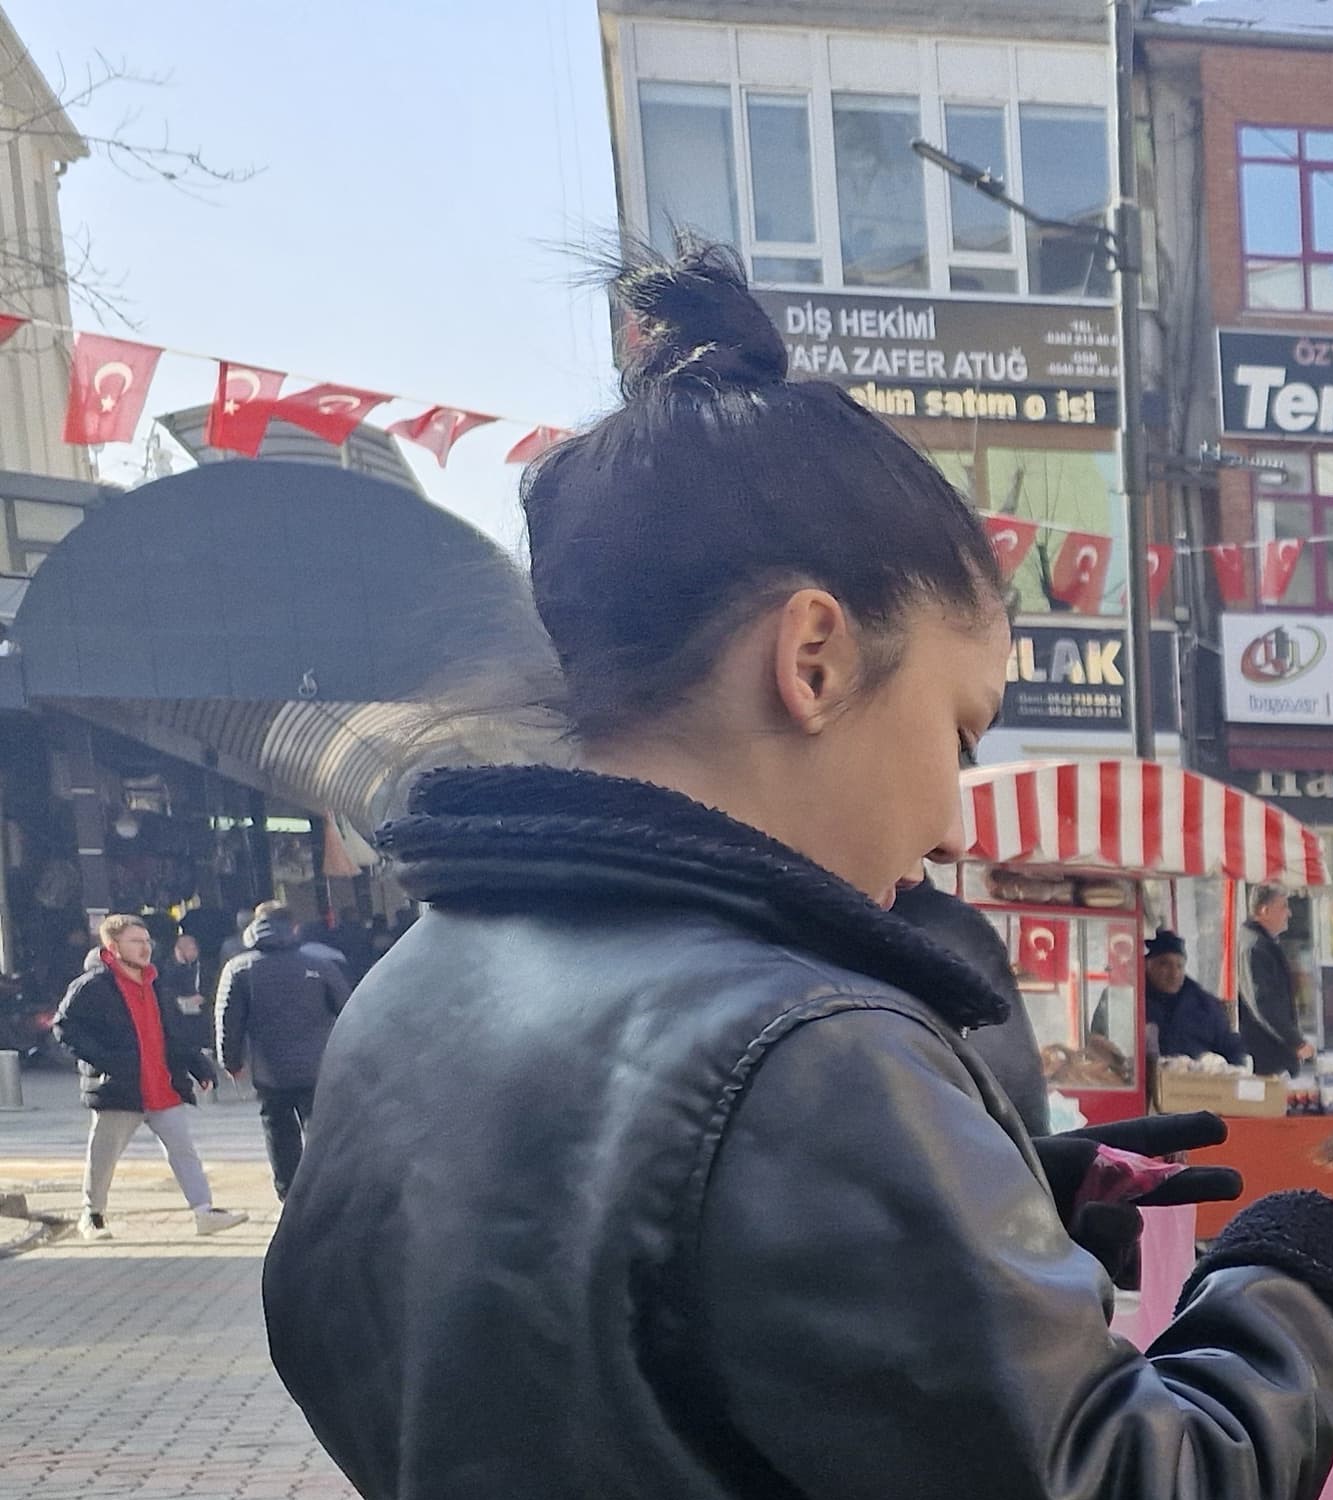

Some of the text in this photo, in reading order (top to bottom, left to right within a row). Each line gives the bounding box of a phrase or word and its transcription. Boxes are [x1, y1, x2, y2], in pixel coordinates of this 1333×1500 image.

[786, 300, 936, 341] DİŞ HEKİMİ
[785, 343, 848, 375] AFA
[851, 346, 946, 379] ZAFER
[952, 346, 1028, 382] ATUĞ
